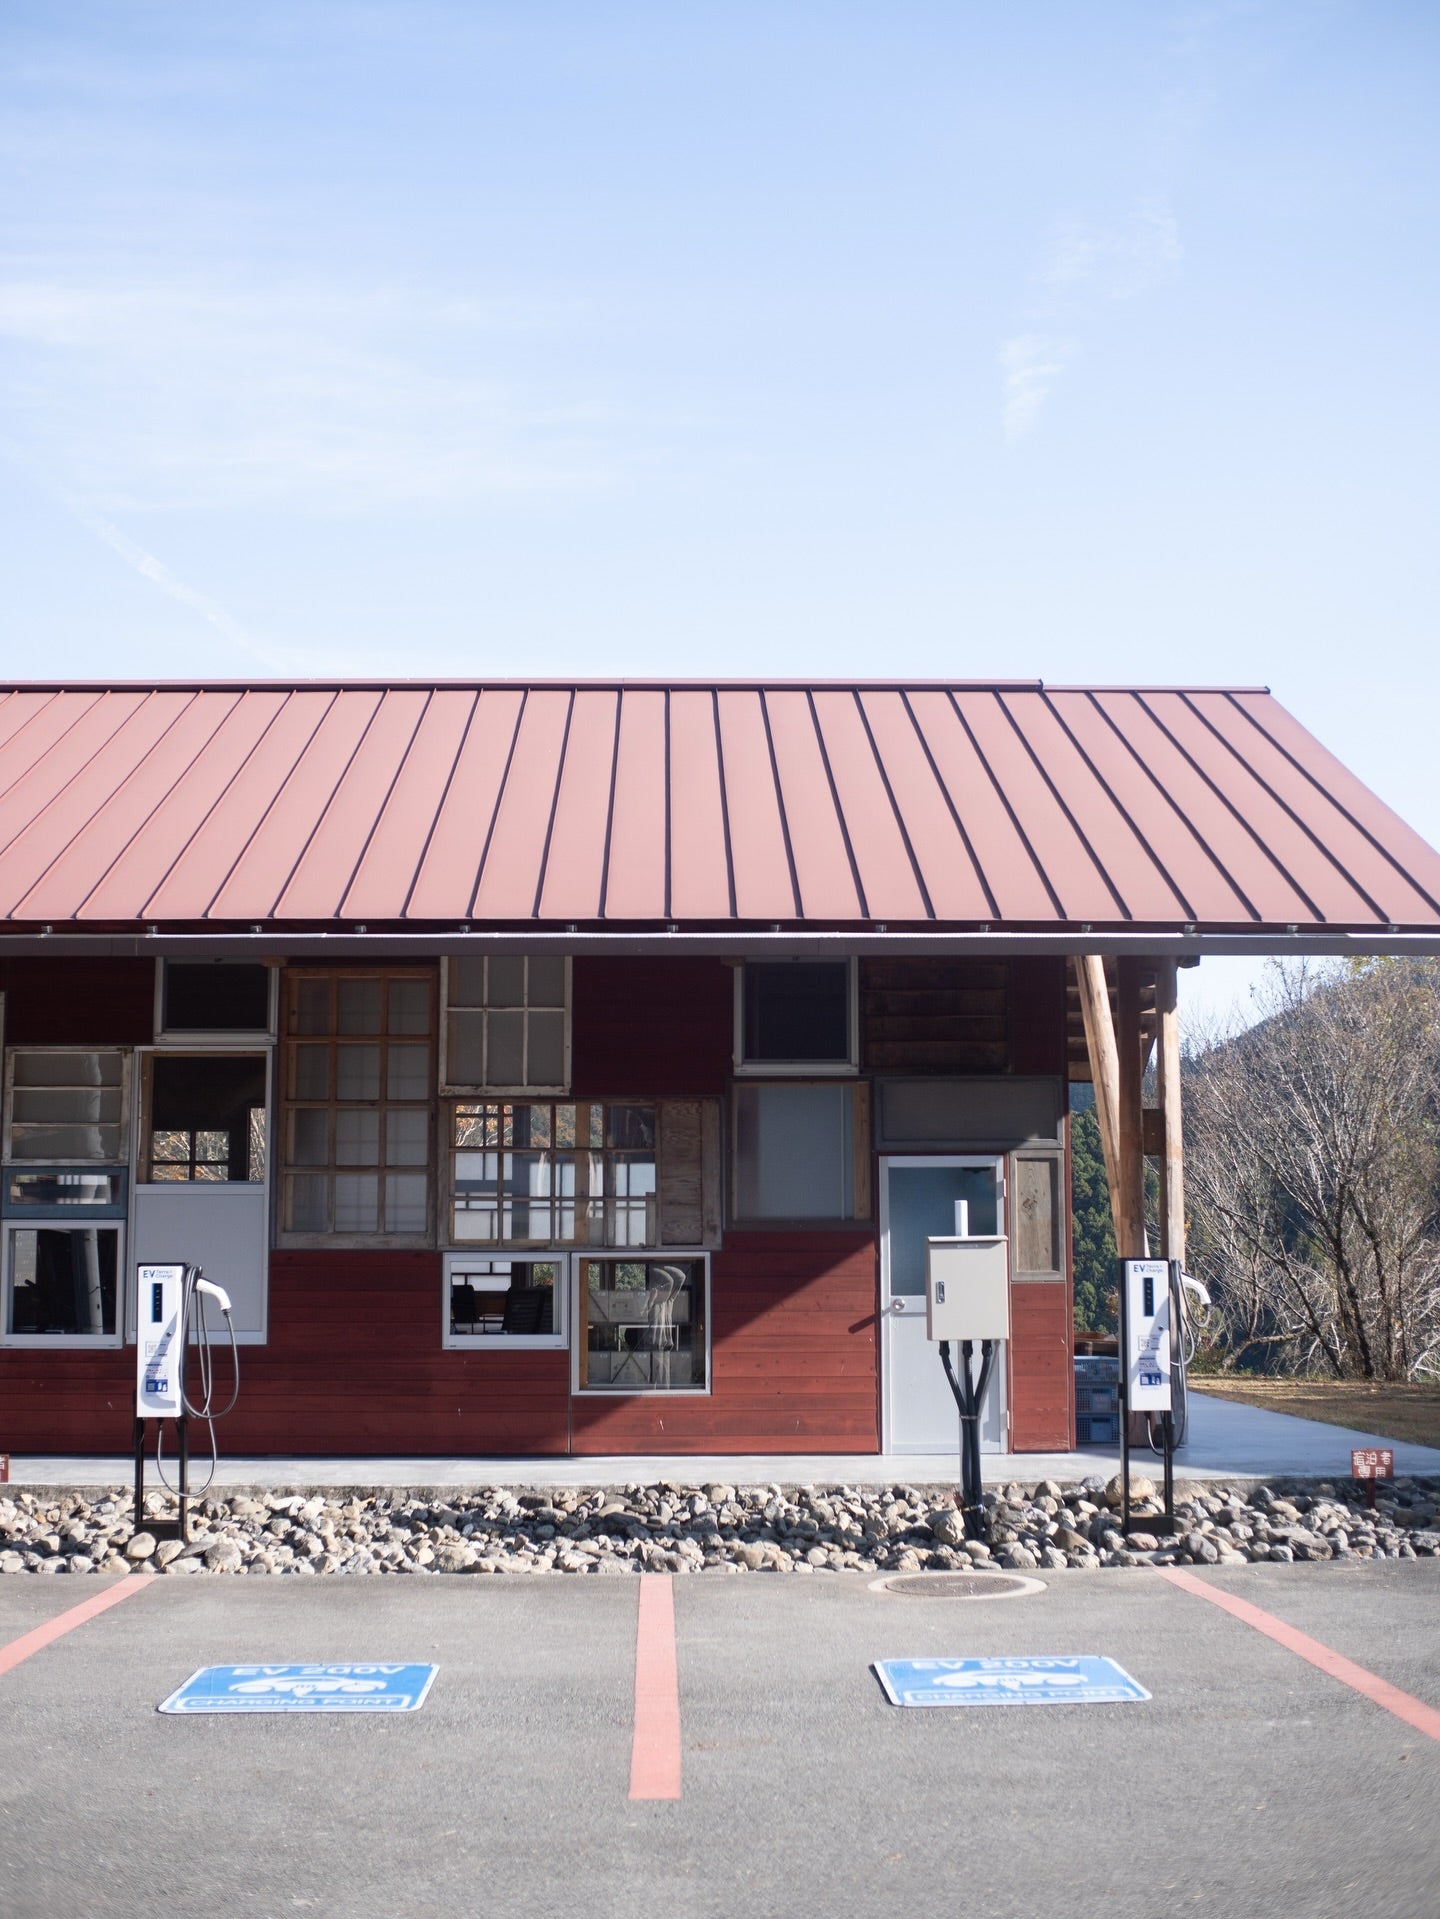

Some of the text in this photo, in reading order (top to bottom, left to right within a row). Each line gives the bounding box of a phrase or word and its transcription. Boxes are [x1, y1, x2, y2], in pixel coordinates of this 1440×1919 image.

[1133, 1264, 1146, 1273] EV
[143, 1270, 156, 1278] EV
[911, 1659, 1080, 1670] EV 200V
[231, 1665, 406, 1676] EV 200V
[915, 1689, 1120, 1700] CHARGING POINT
[189, 1697, 399, 1707] CHARGING POINT
